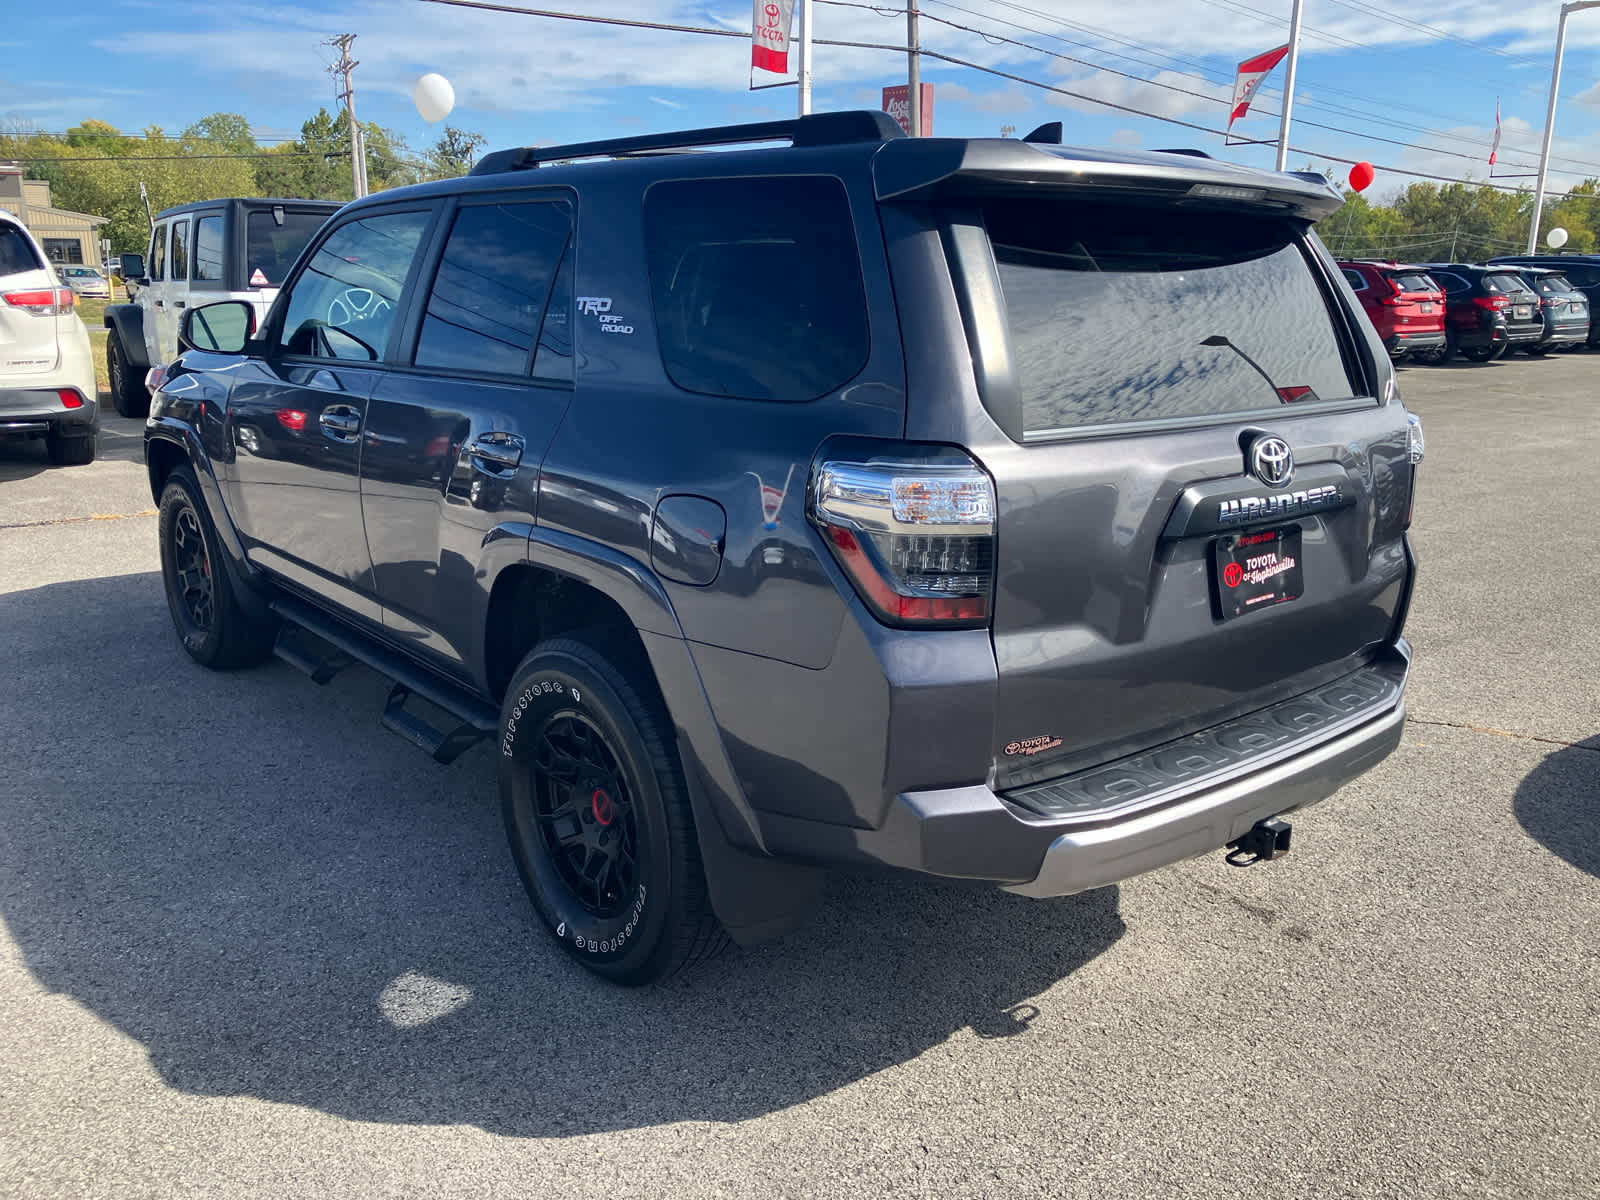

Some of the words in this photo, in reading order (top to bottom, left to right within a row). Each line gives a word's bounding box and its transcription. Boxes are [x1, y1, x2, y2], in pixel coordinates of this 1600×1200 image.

[576, 297, 612, 315] TRD
[599, 314, 625, 323] OFF
[601, 324, 634, 334] ROAD
[1246, 553, 1277, 570] TOYOTA
[1250, 557, 1295, 584] Hopkinsville
[1021, 736, 1050, 747] TOYOTA
